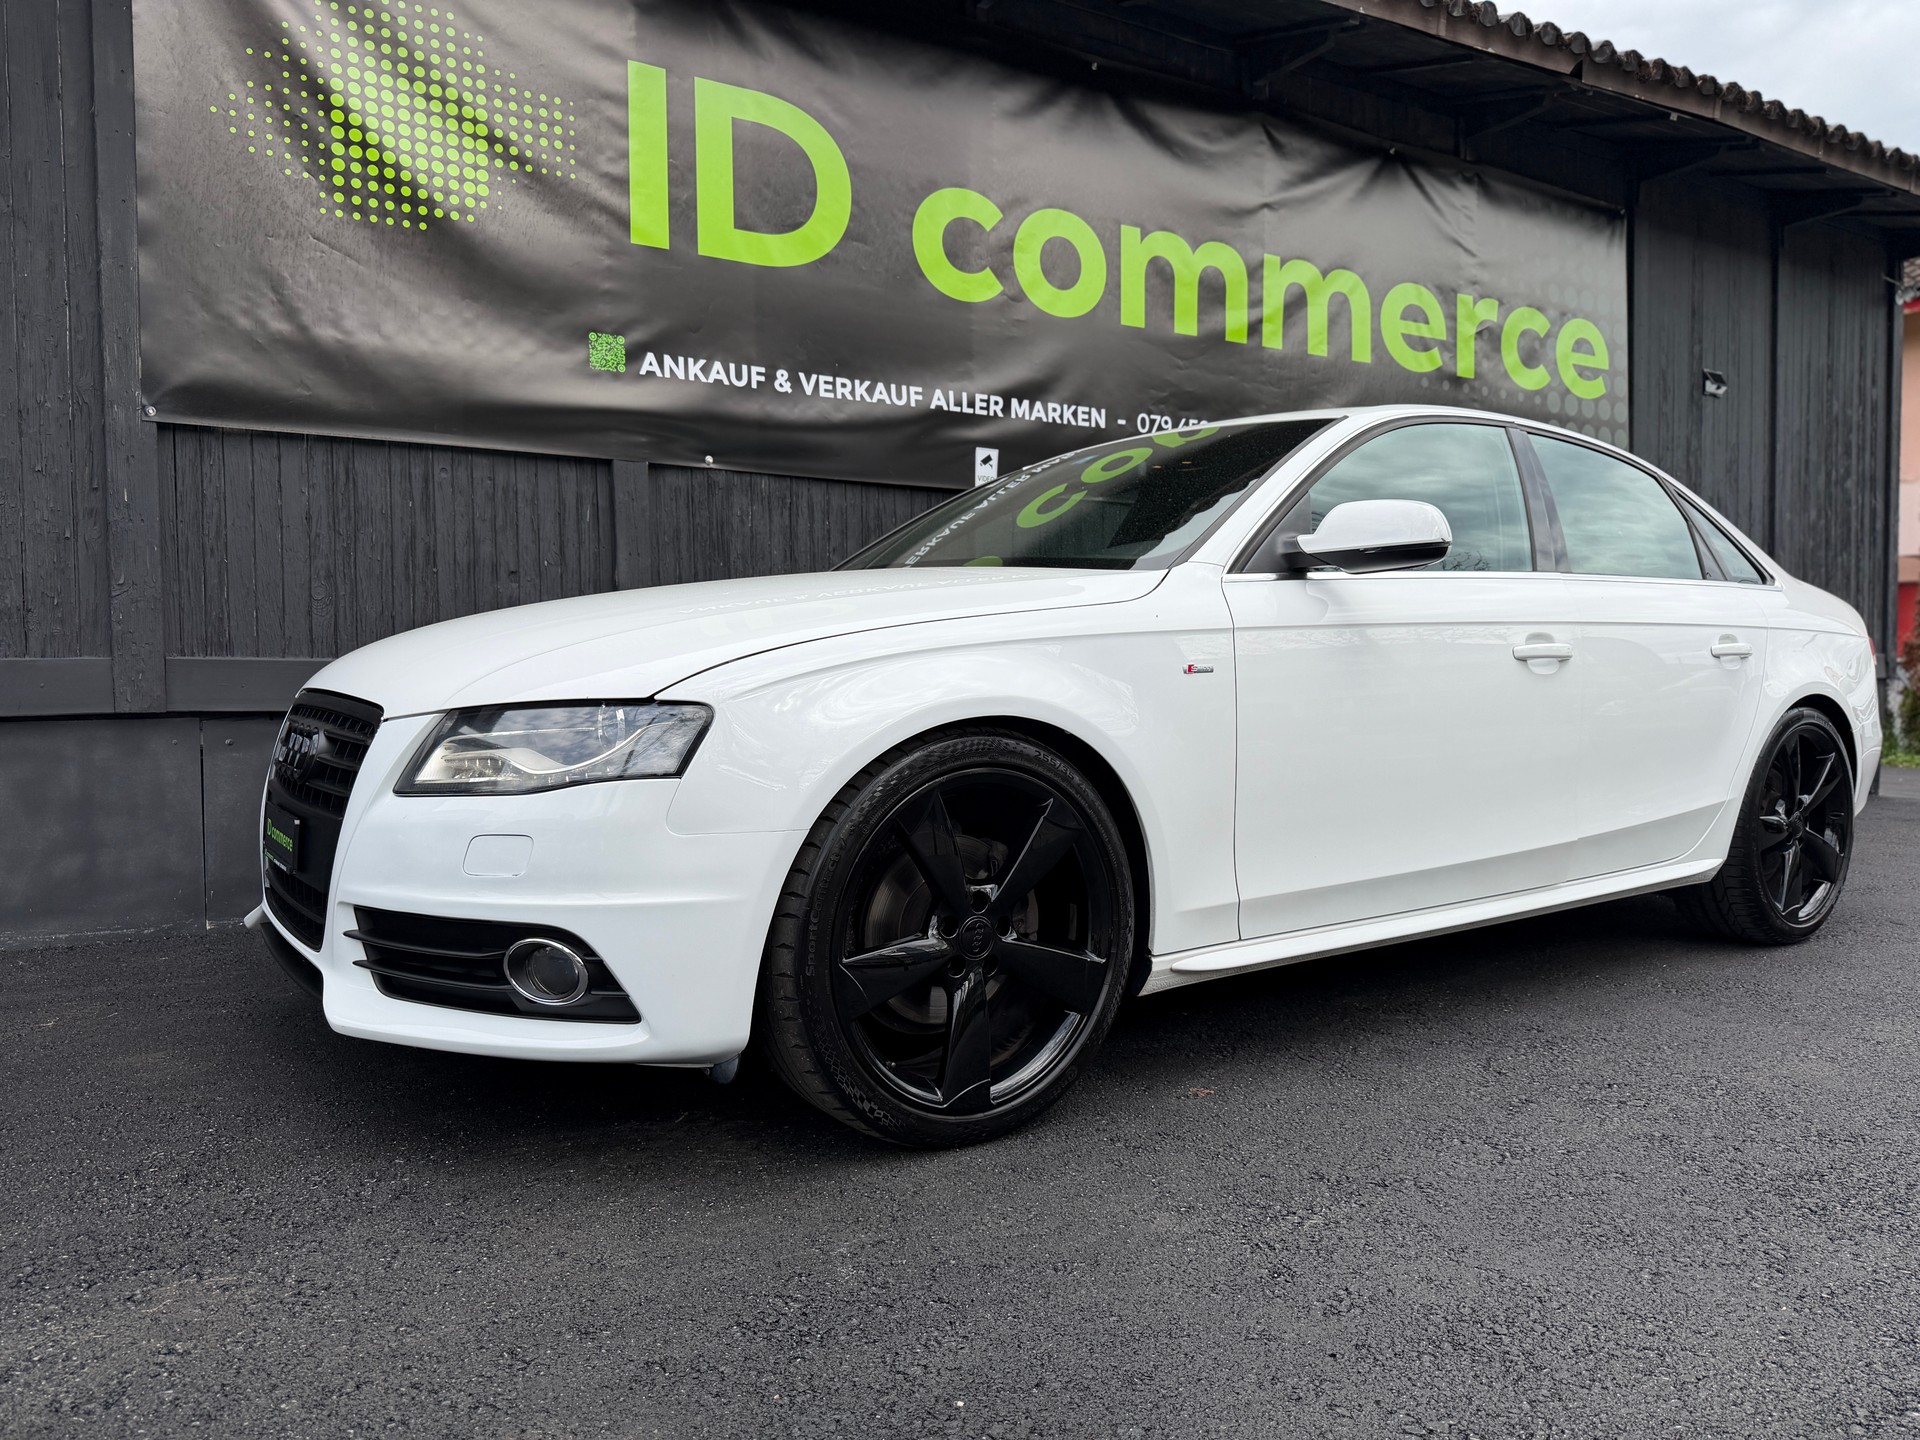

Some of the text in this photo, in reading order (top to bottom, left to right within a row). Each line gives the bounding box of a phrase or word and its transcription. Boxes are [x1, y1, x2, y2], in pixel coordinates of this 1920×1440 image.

[628, 59, 1609, 399] ID commerce
[639, 351, 766, 389] ANKAUF
[774, 369, 793, 394] &
[798, 372, 923, 407] VERKAUF
[930, 389, 1004, 417] ALLER
[1010, 398, 1106, 428] MARKEN
[1137, 413, 1172, 433] 079
